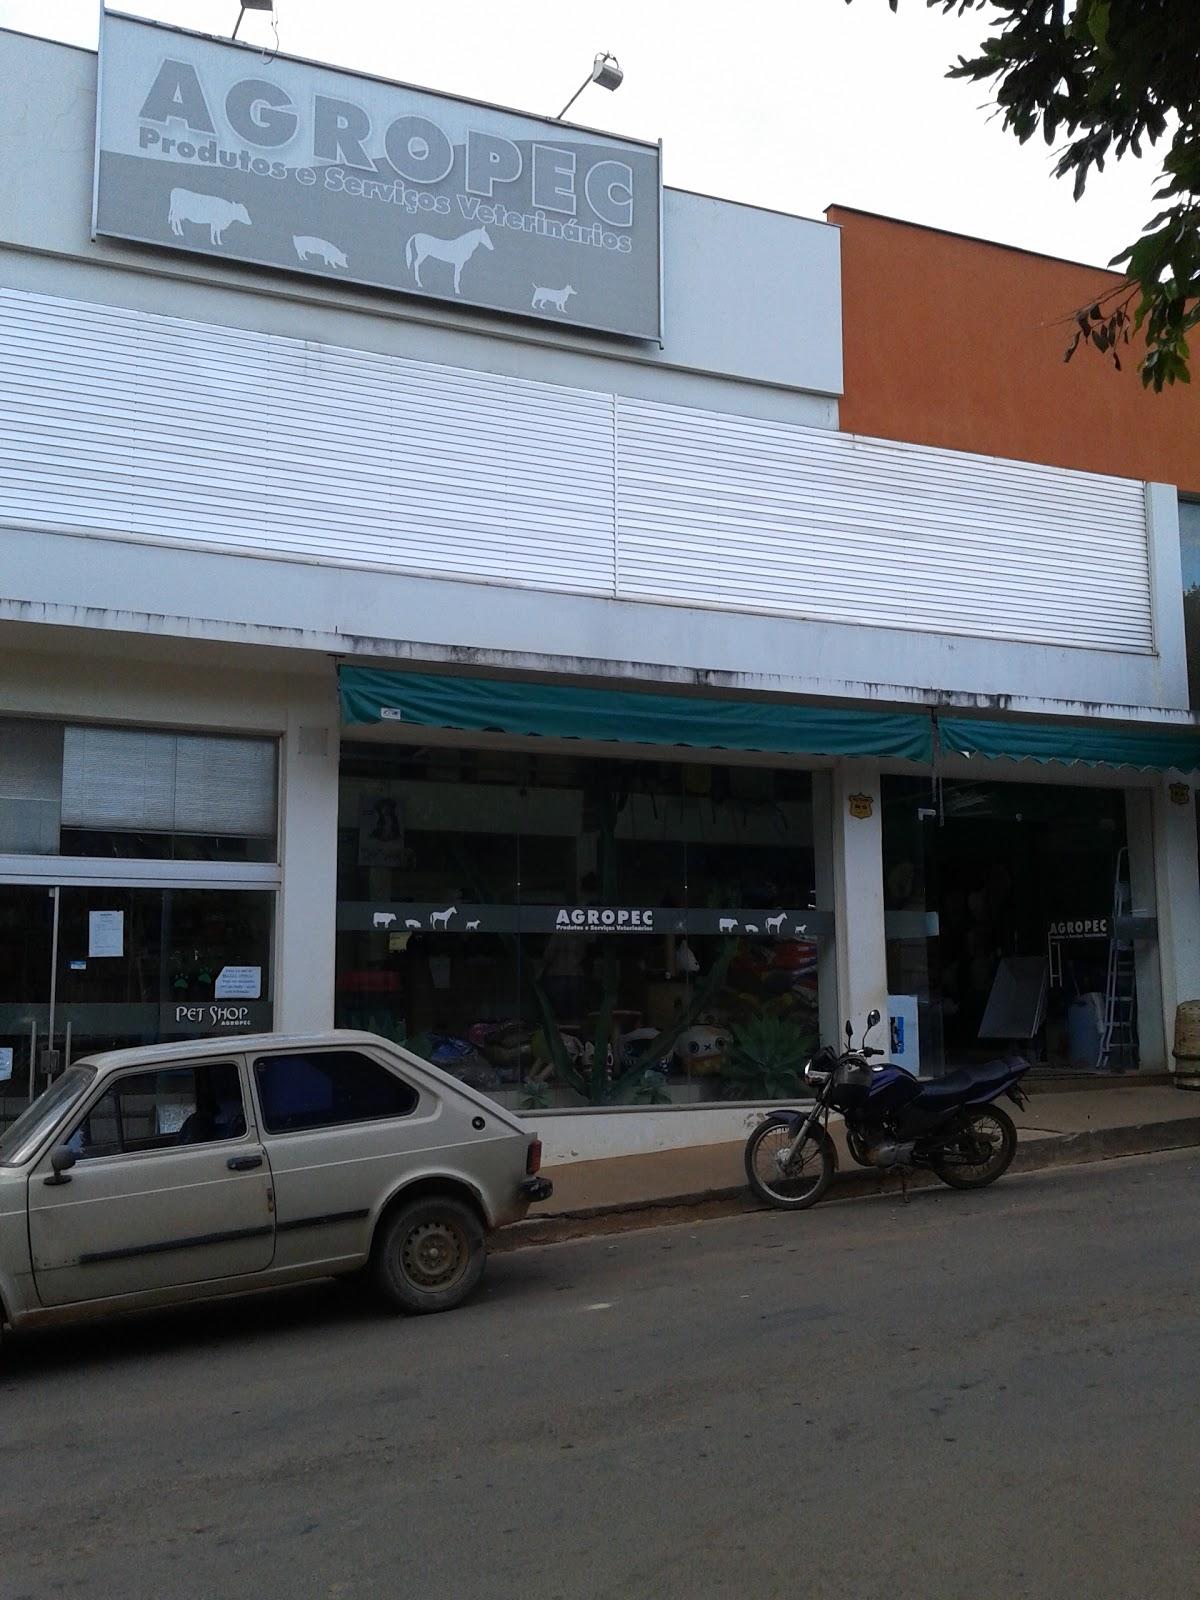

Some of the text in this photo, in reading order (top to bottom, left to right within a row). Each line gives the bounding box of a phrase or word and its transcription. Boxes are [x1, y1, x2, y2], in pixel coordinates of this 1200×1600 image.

[138, 57, 633, 226] AGROPEC
[138, 125, 632, 253] Produtos e Serviços Veterinários
[556, 909, 653, 925] AGROPEC
[1049, 919, 1107, 935] AGROPEC
[176, 1005, 249, 1026] PET SHOP
